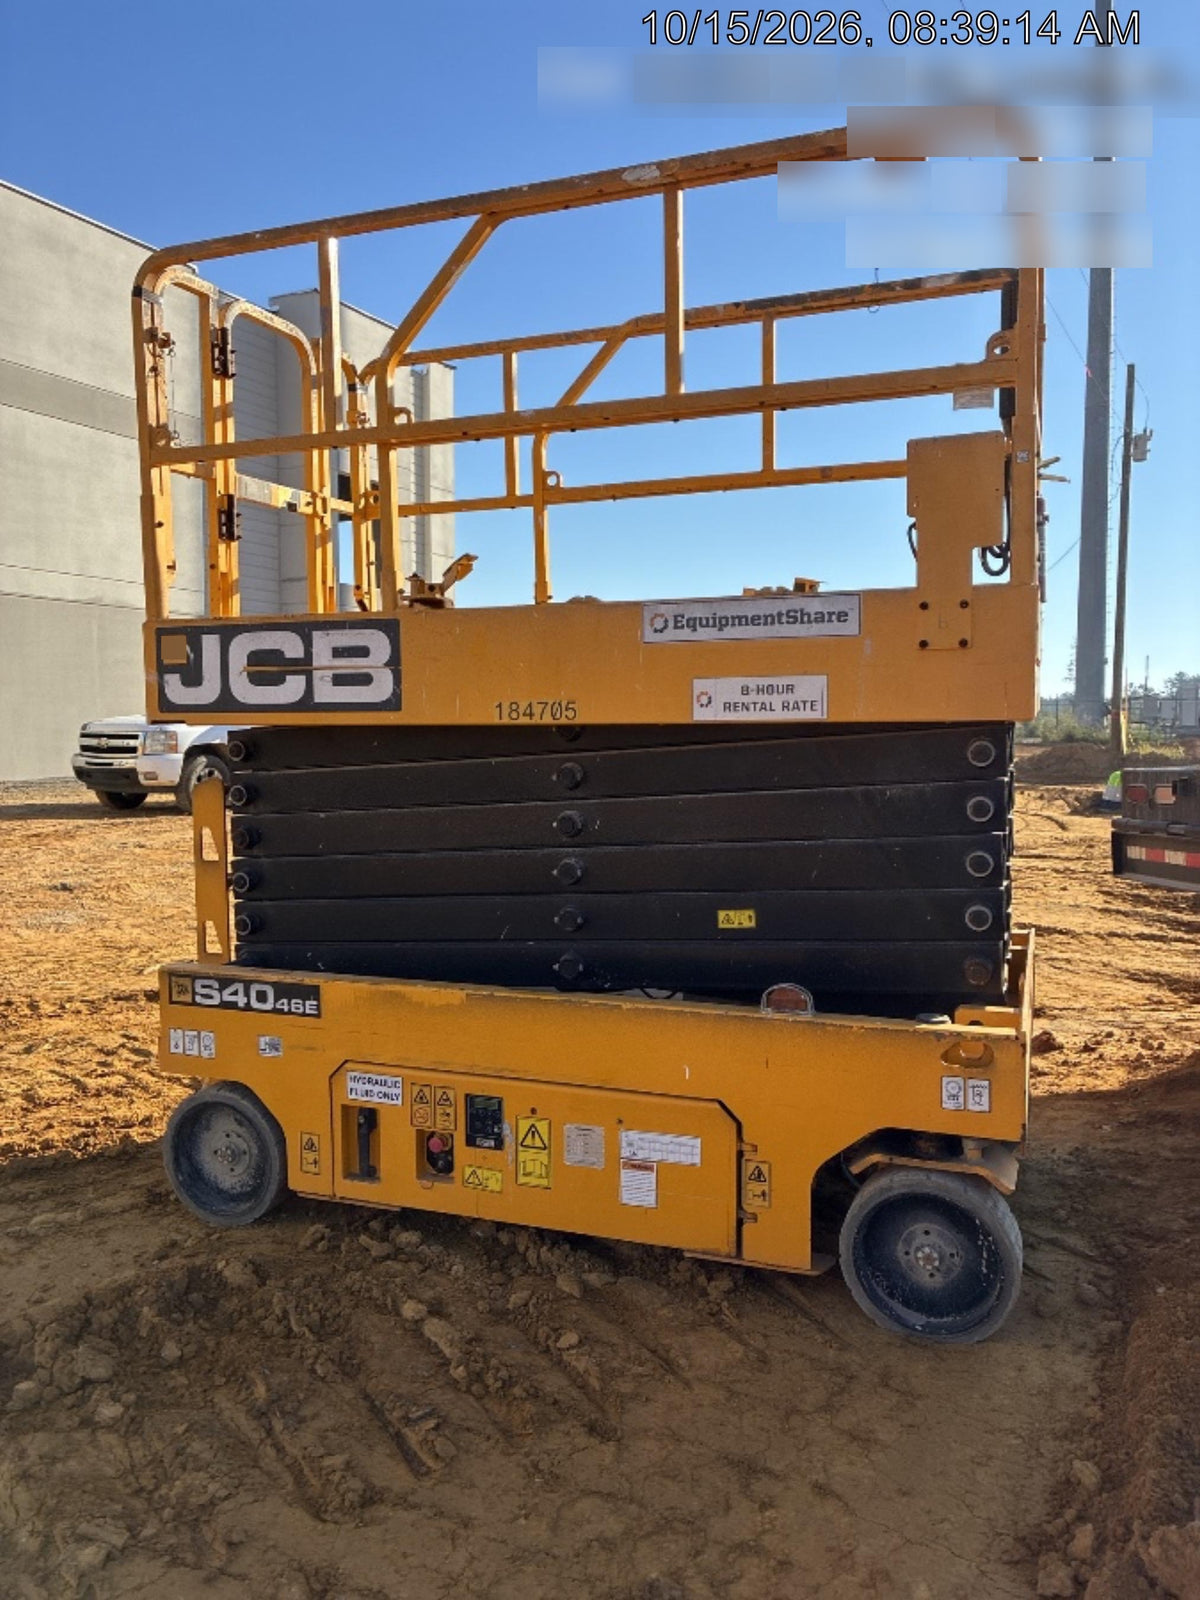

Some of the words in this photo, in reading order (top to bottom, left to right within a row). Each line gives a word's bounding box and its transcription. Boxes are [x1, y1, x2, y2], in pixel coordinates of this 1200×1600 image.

[673, 607, 849, 633] EquipmentShare
[163, 628, 394, 705] JCB
[740, 684, 796, 696] 8-HOUR
[495, 700, 577, 721] 184705
[722, 701, 777, 713] RENTAL
[781, 700, 819, 712] RATE
[376, 1090, 401, 1102] ONLY
